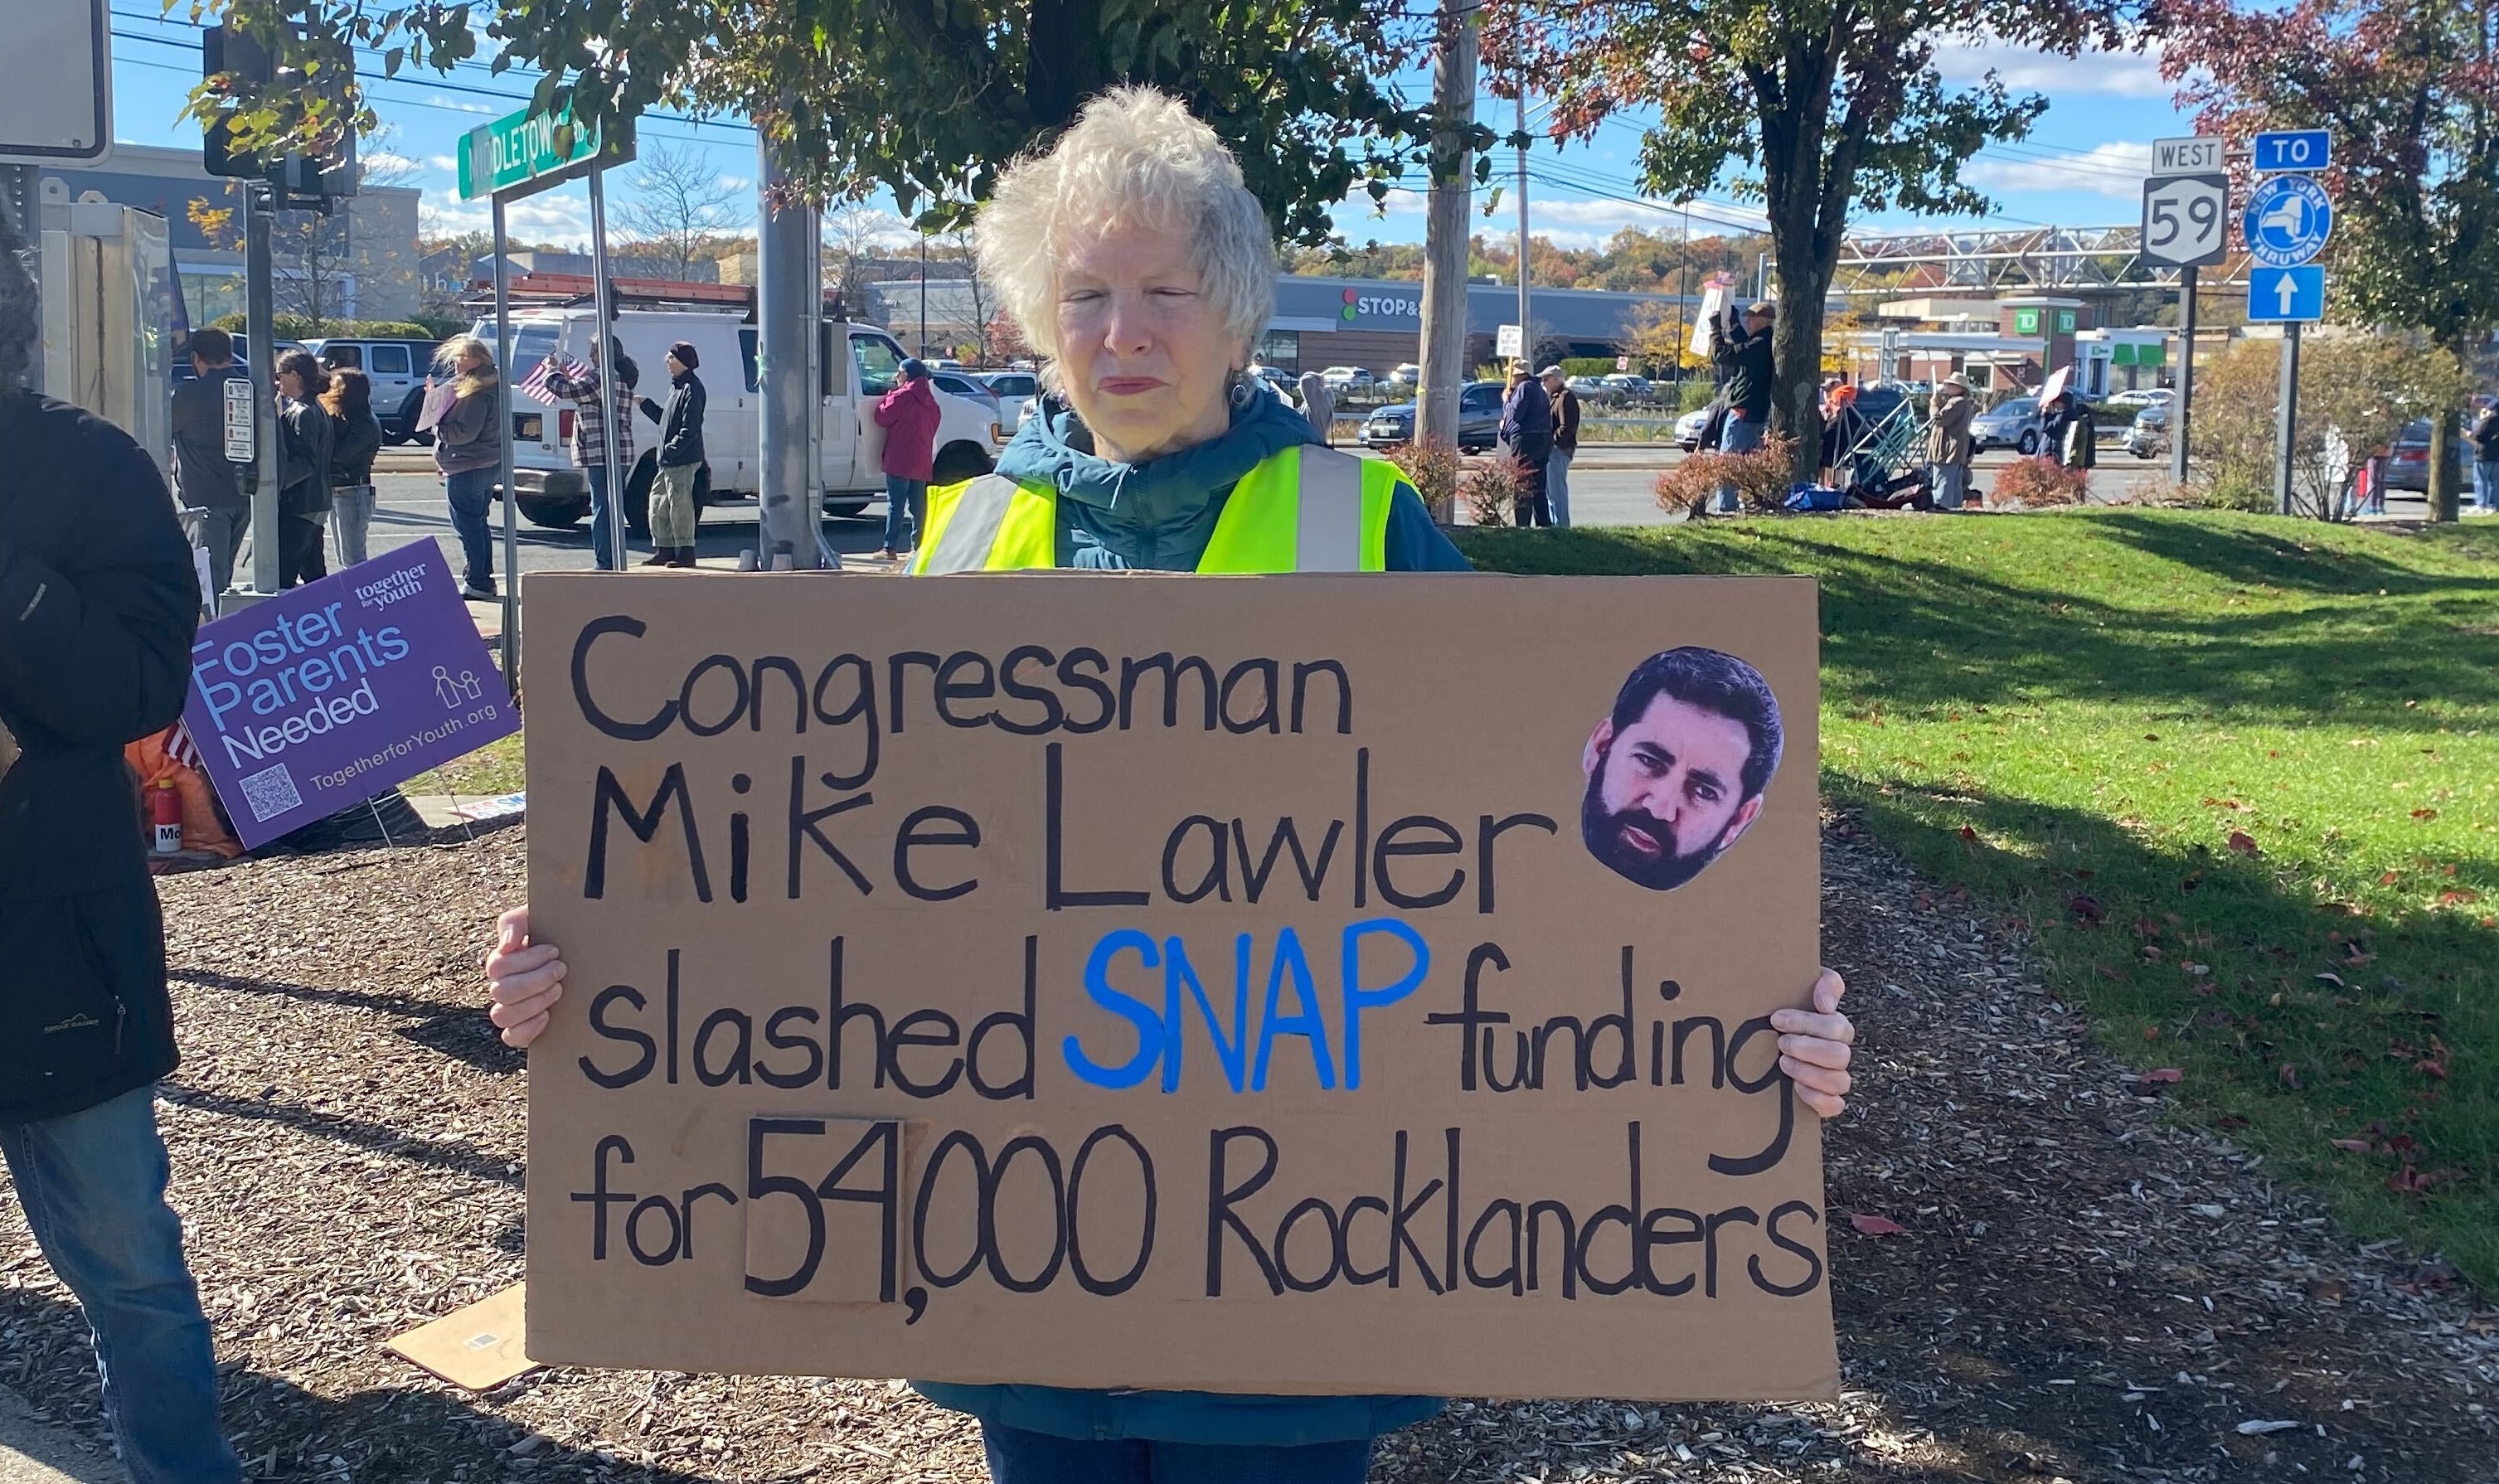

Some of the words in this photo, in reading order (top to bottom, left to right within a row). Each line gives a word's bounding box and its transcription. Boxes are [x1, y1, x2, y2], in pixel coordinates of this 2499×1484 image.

[2161, 143, 2215, 167] WEST
[2272, 138, 2310, 162] TO
[2150, 196, 2218, 246] 59
[2249, 182, 2278, 216] NEW
[2287, 177, 2327, 211] YORK
[2250, 231, 2322, 265] THRUWAY
[2018, 313, 2036, 328] TD
[355, 563, 426, 599] together
[361, 599, 374, 608] for
[373, 580, 423, 612] youth
[192, 602, 343, 690] Foster
[200, 626, 410, 732] Parents
[221, 677, 380, 769] Needed
[570, 614, 1352, 792] Congressman
[309, 704, 497, 791] TogetherforYouth.org
[584, 754, 982, 904] Mike
[1045, 742, 1559, 914] Lawler
[1062, 917, 1431, 1094] SNAP
[1423, 941, 1795, 1176] funding
[570, 1134, 740, 1267] for
[745, 1118, 1157, 1326] 54,000
[1206, 1120, 1823, 1302] Rocklanders
